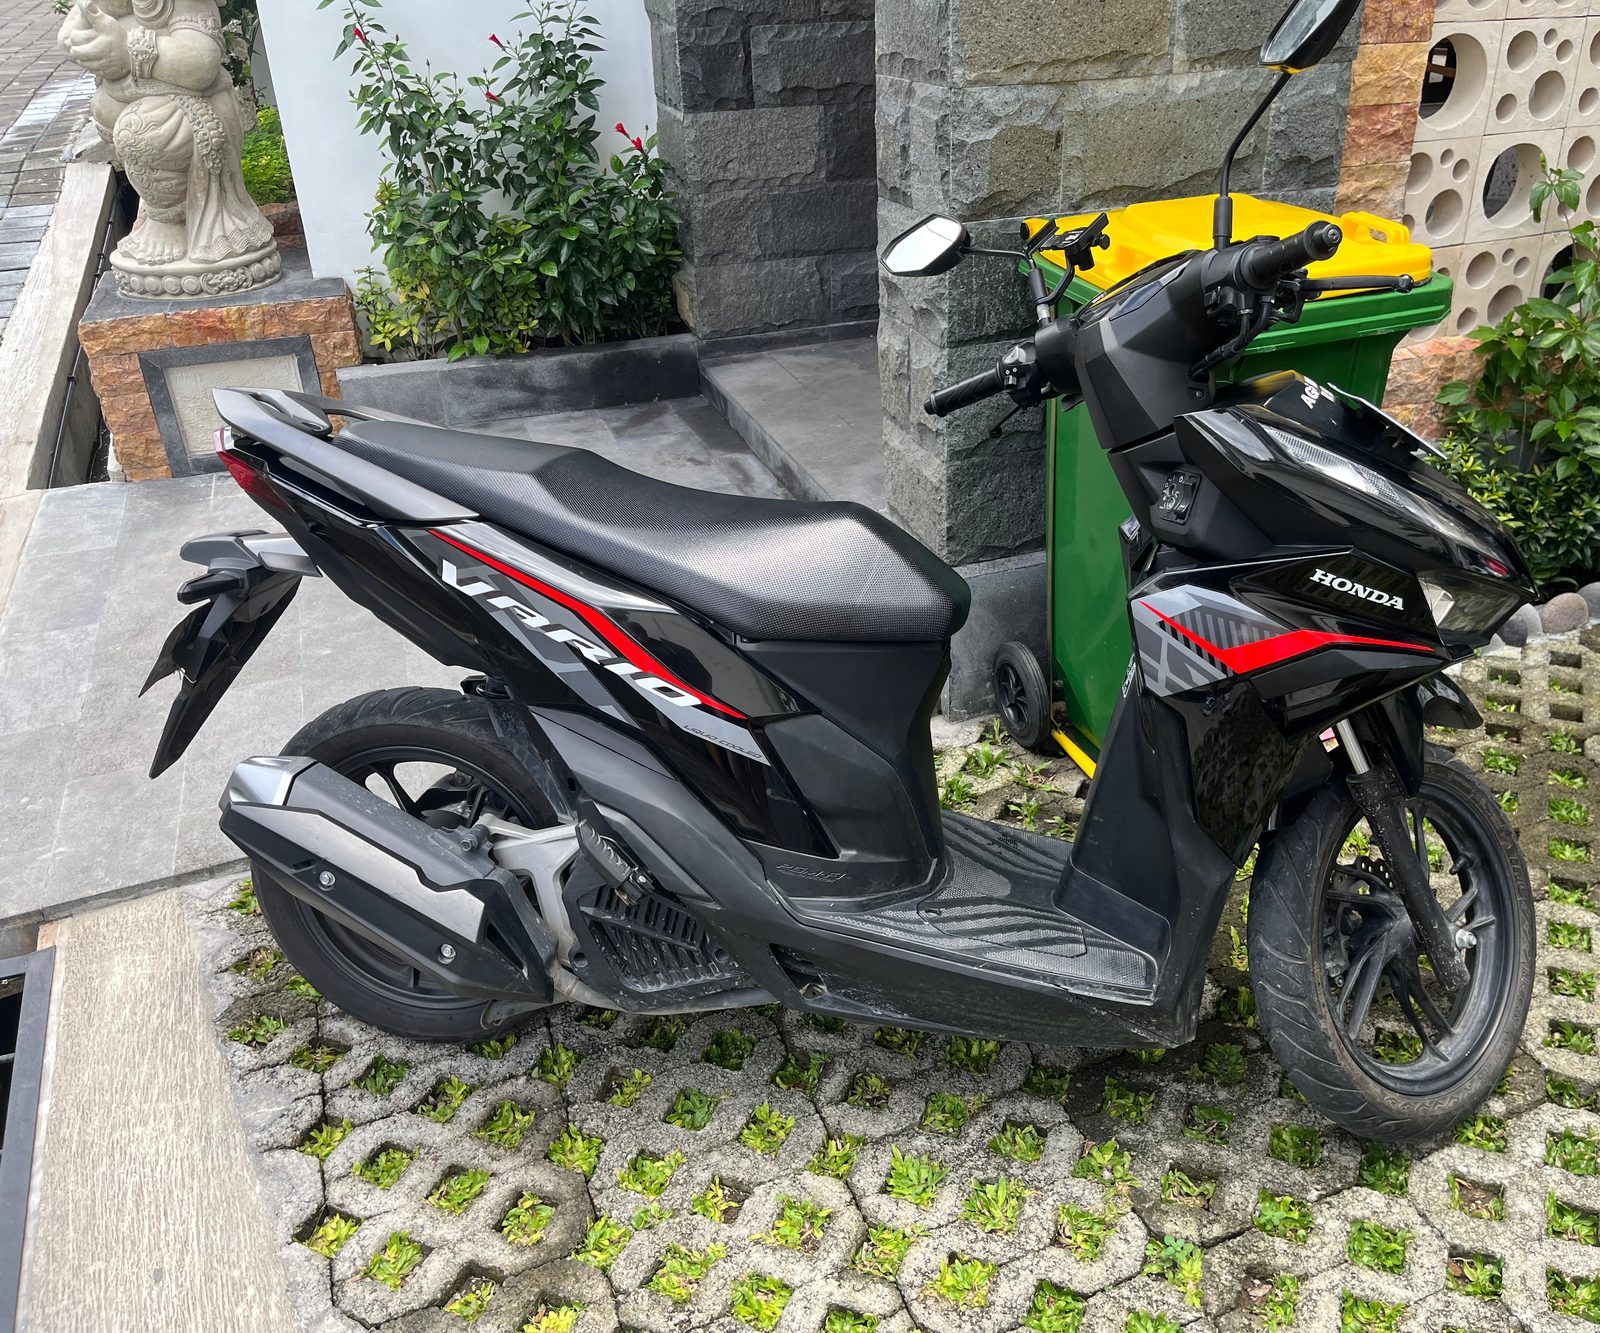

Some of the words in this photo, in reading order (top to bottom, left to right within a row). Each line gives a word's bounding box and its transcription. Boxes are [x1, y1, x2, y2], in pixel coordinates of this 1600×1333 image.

[1309, 568, 1404, 610] HONDA
[441, 559, 702, 707] VARIO
[683, 724, 718, 741] LIQUID
[719, 740, 762, 759] COOLED
